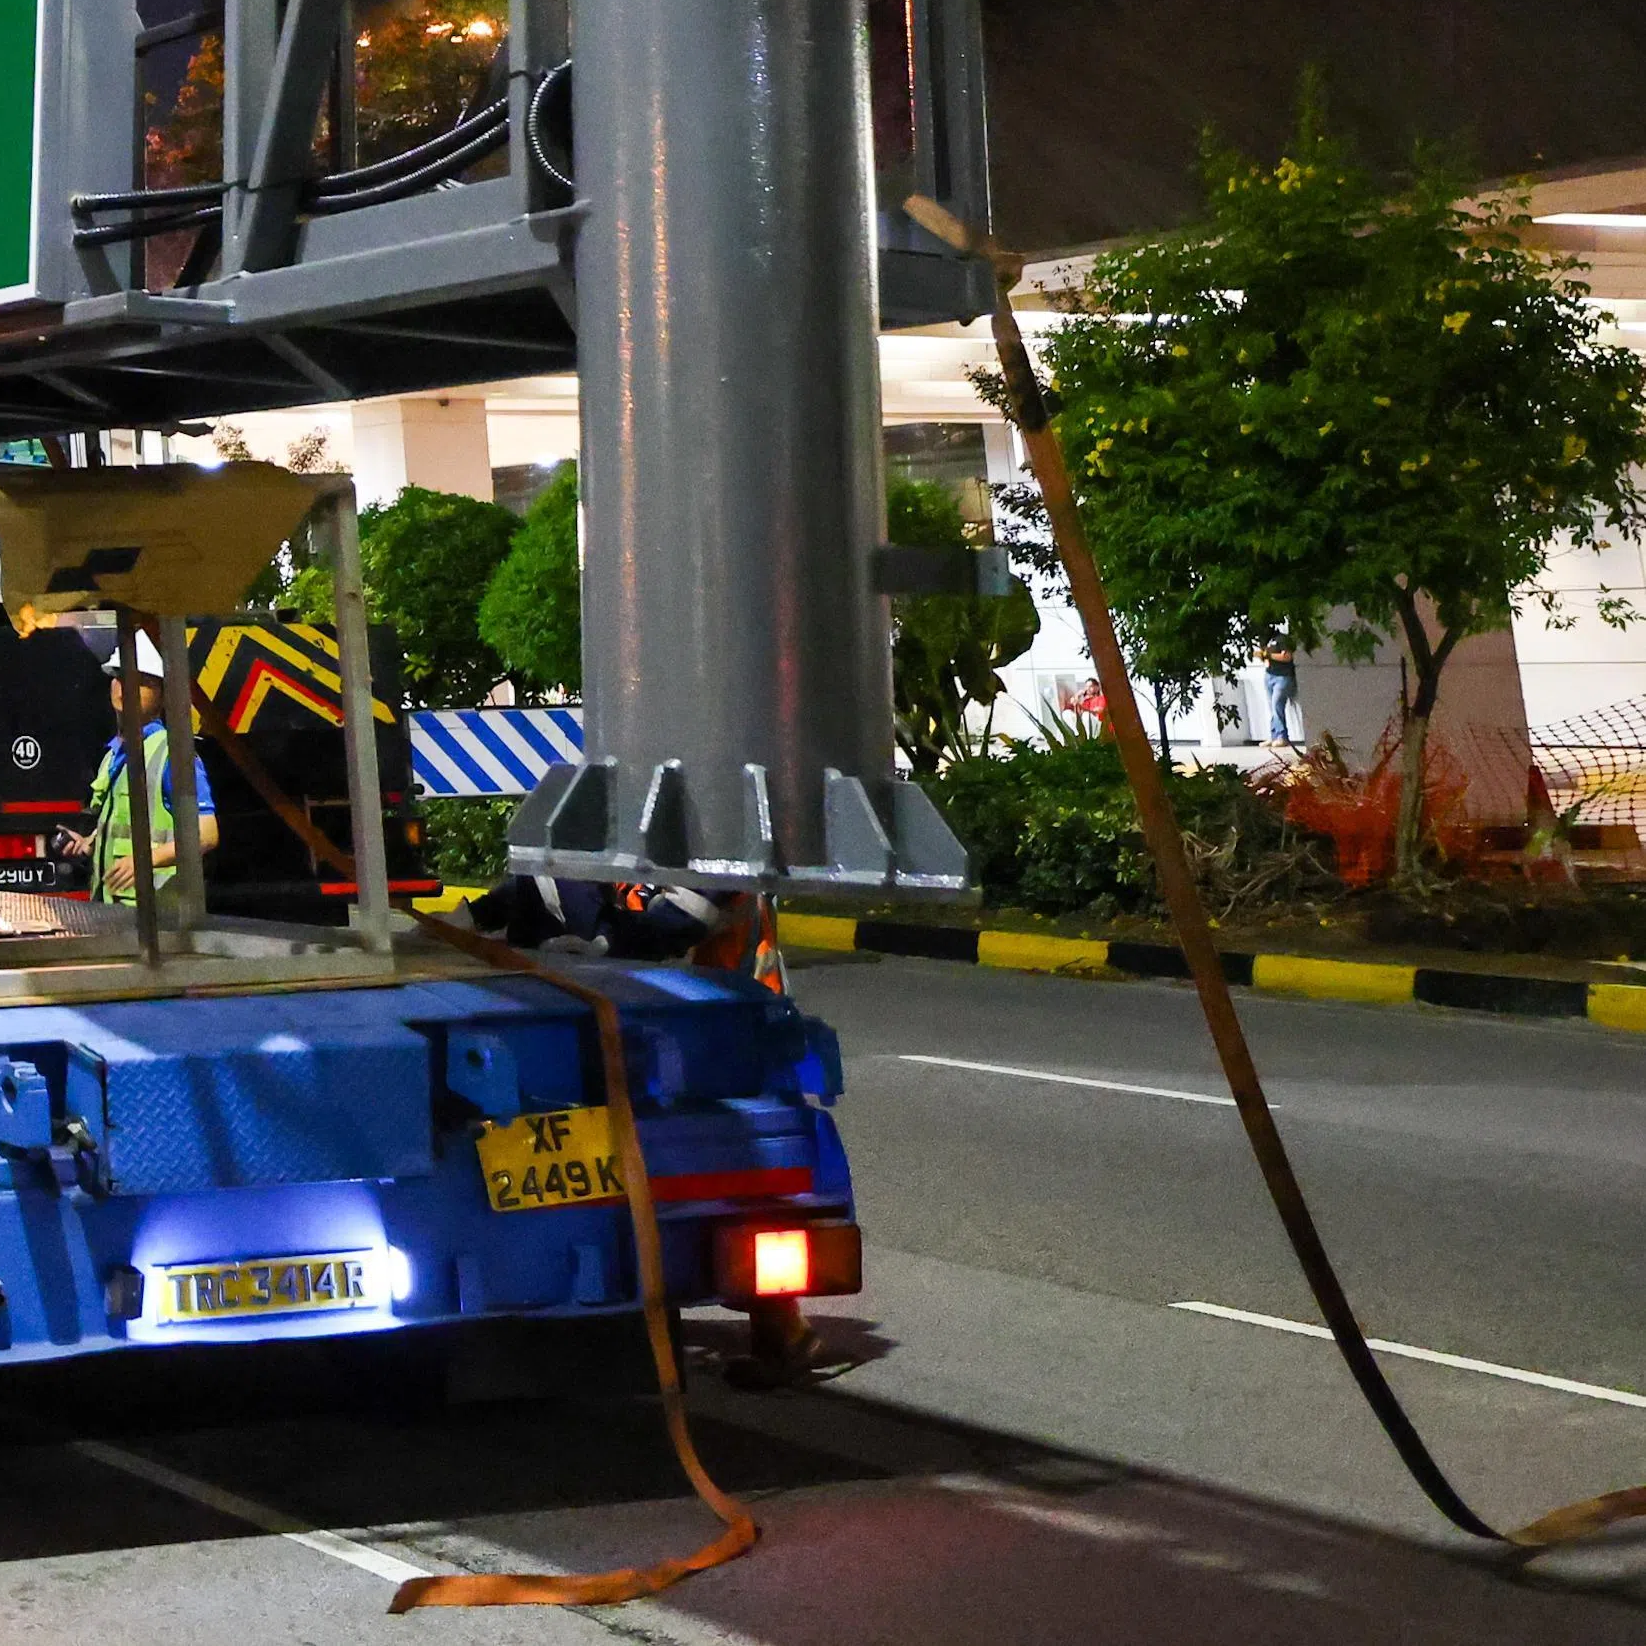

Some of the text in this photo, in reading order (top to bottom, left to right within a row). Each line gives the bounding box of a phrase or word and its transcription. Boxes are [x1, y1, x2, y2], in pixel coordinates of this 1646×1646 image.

[16, 741, 35, 759] 40
[526, 1114, 570, 1153] XF
[167, 1269, 241, 1312] TRC
